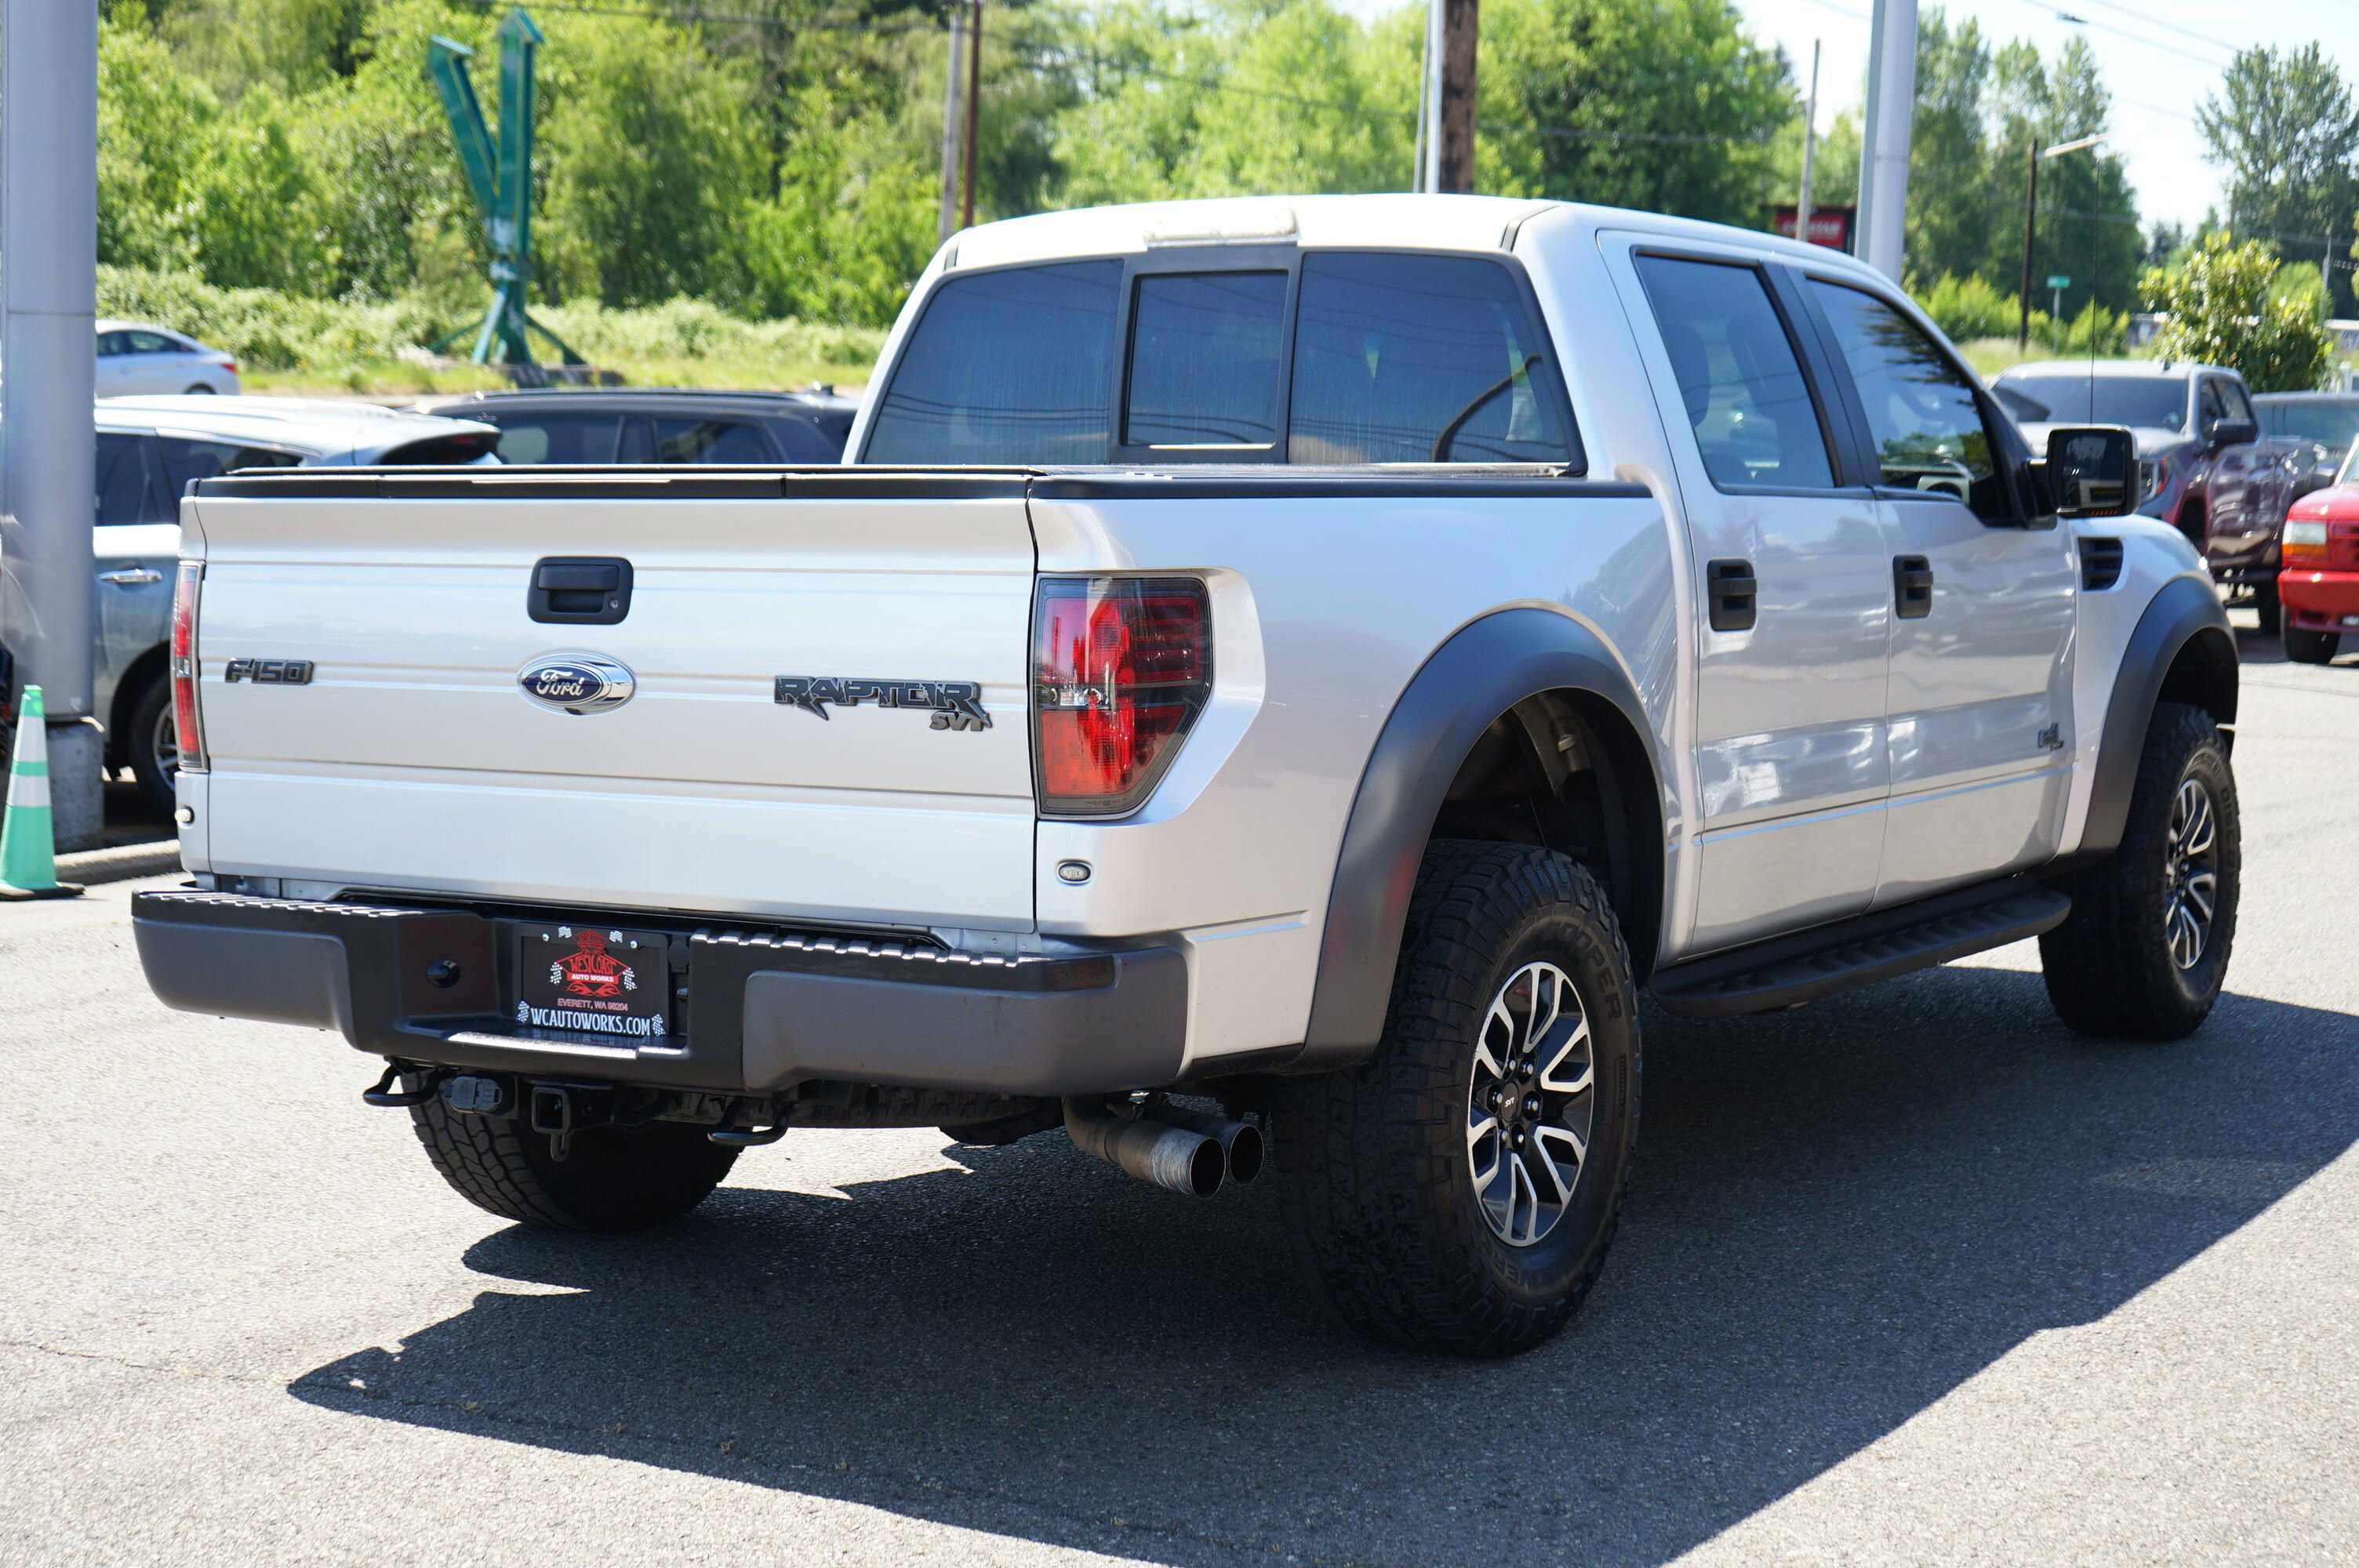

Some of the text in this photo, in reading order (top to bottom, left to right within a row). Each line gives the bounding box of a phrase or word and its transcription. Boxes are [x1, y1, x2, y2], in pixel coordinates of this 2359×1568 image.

[536, 669, 584, 696] Ford
[774, 675, 992, 728] RAPTOR
[929, 710, 986, 731] SVT
[558, 997, 628, 1012] EVERETT, WA 98204
[530, 1007, 651, 1036] WCAUTOWORKS.COM
